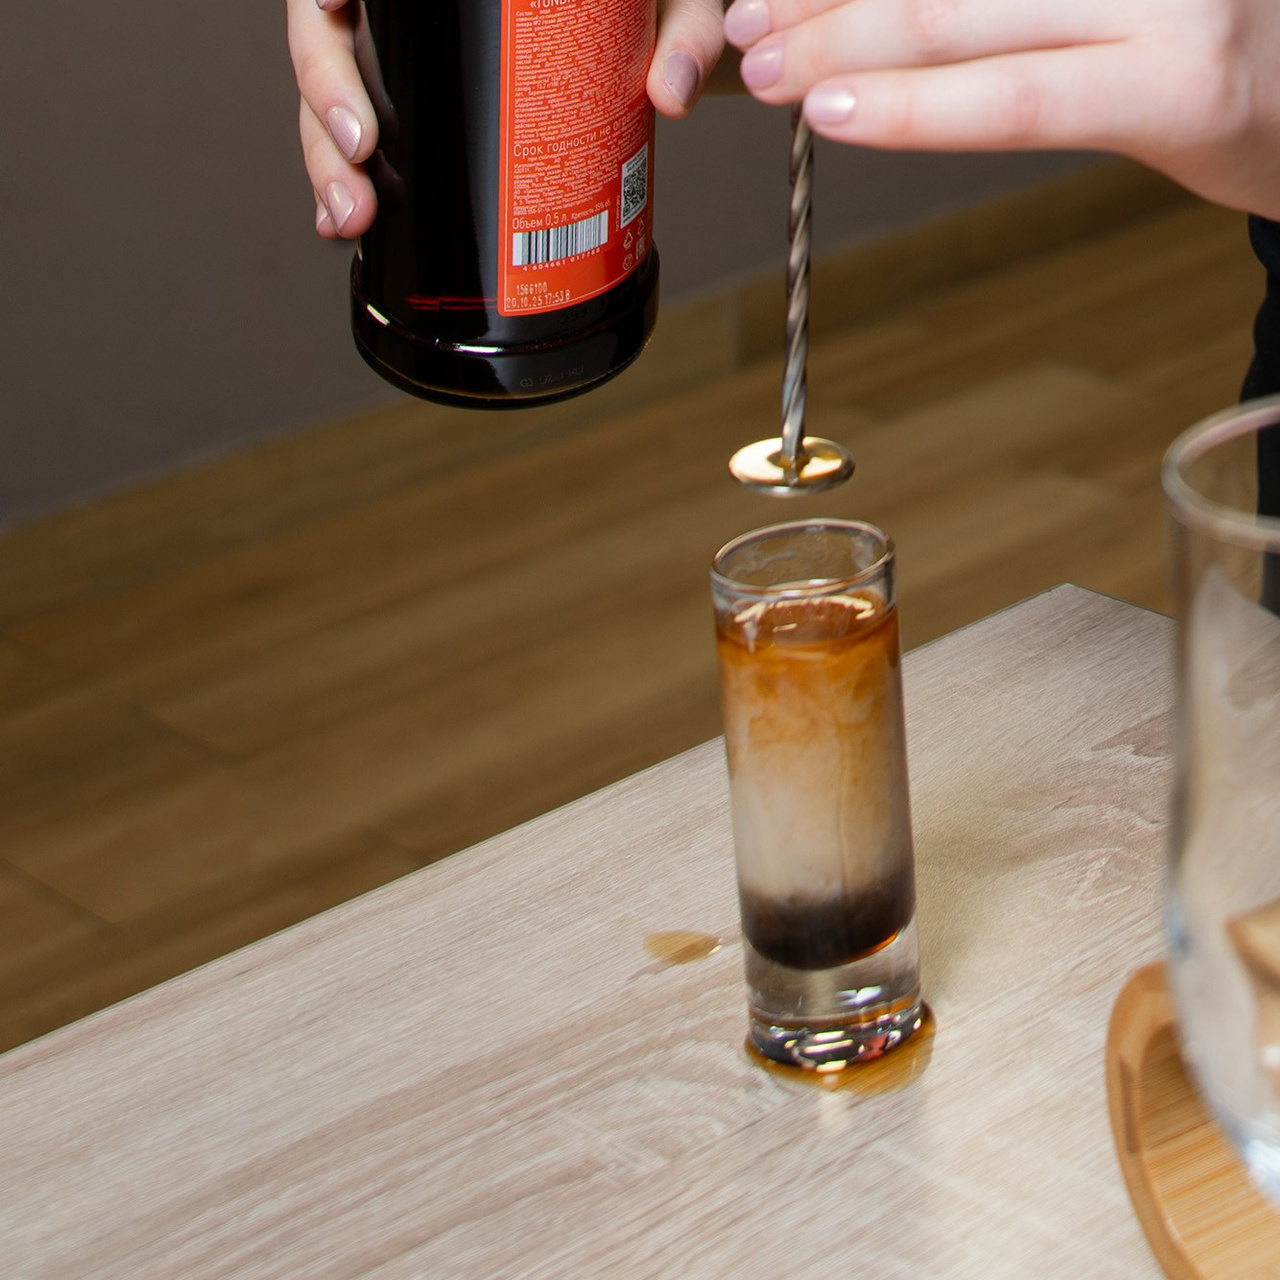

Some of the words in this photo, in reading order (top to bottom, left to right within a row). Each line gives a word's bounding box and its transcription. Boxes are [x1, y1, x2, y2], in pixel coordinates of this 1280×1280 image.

[513, 144, 543, 159] Срок
[547, 131, 597, 153] годности
[600, 125, 611, 137] не
[512, 217, 543, 230] Объем
[545, 212, 560, 226] 0,5
[506, 295, 543, 308] 20.10.25
